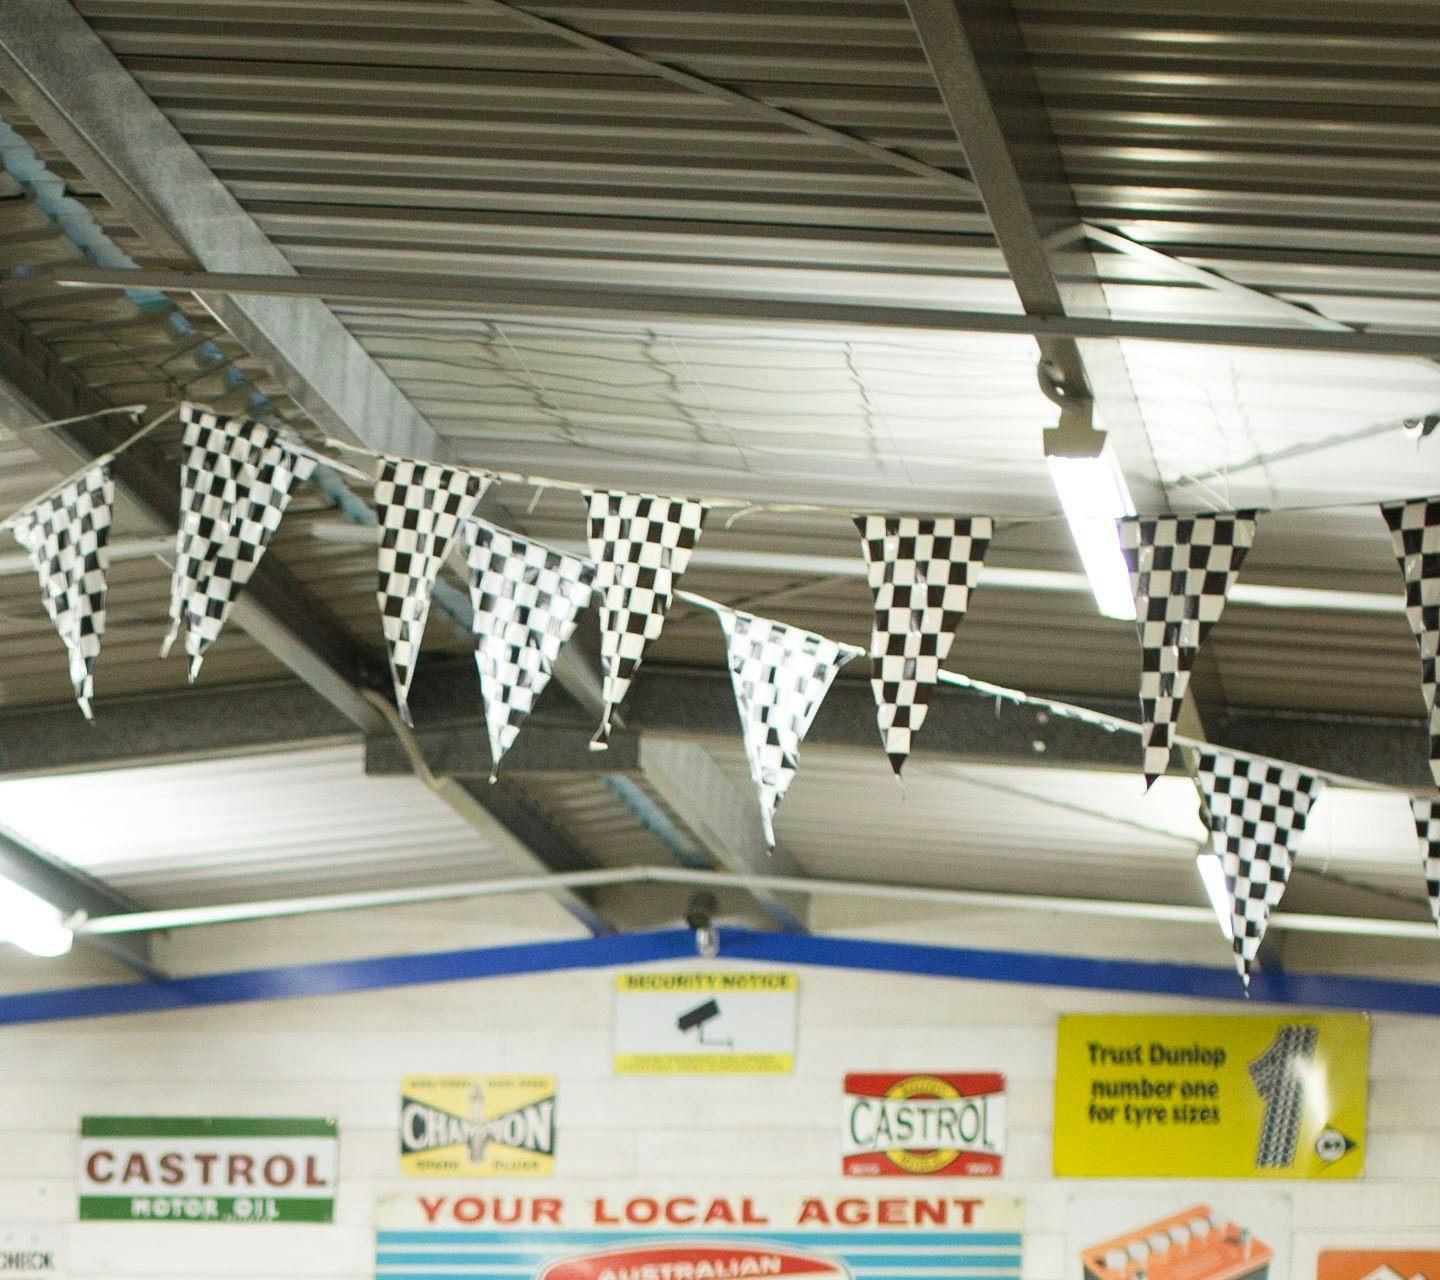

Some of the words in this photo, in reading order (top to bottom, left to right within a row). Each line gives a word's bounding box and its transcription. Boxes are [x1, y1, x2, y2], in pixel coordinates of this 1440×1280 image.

[626, 975, 714, 991] SECURITY
[722, 975, 791, 990] NOTICE
[1087, 1043, 1143, 1066] Trust
[1148, 1043, 1226, 1069] Dunlop
[1091, 1079, 1173, 1100] number
[1180, 1081, 1219, 1100] one
[850, 1095, 996, 1150] CASTROL
[1087, 1103, 1119, 1124] for
[1124, 1104, 1167, 1126] tyre
[1172, 1103, 1220, 1124] sizes
[85, 1150, 327, 1188] CASTROL
[130, 1199, 220, 1219] MOTOR
[233, 1199, 279, 1219] OIL
[418, 1196, 564, 1225] YOUR
[594, 1196, 770, 1225] LOCAL
[797, 1196, 985, 1226] AGENT
